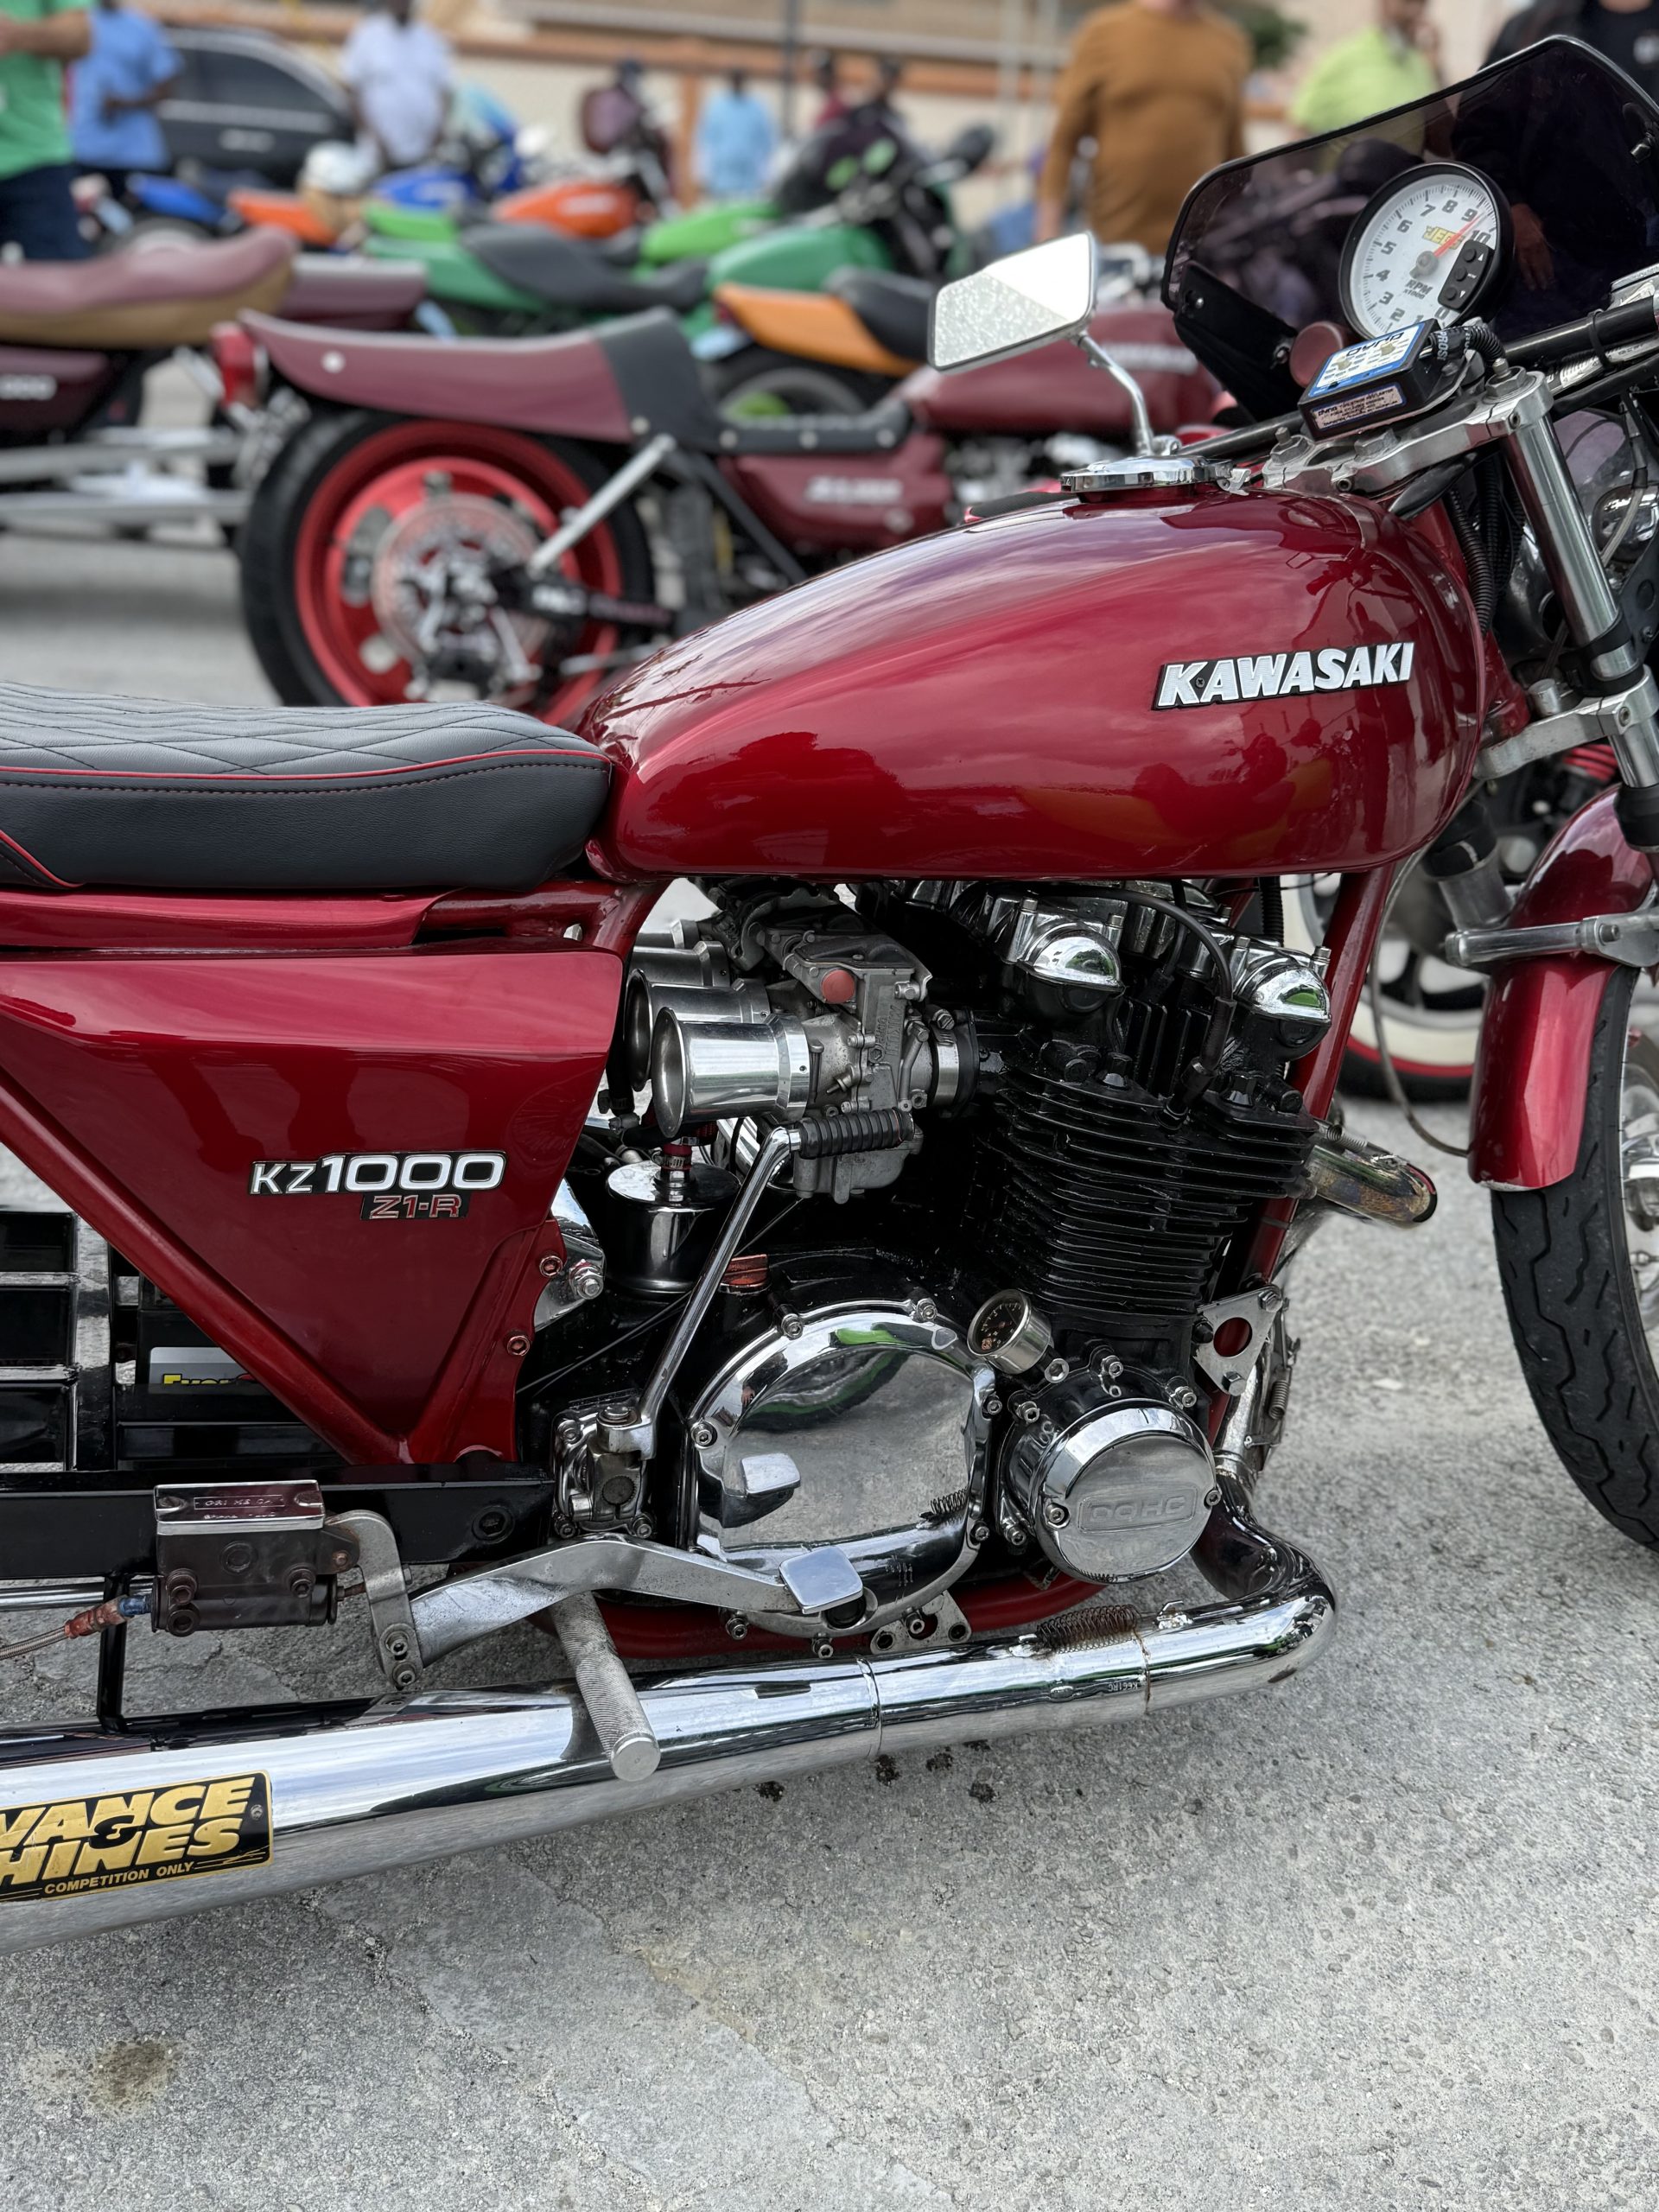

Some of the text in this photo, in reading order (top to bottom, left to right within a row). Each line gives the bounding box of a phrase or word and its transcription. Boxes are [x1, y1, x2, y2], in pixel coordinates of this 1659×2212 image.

[1421, 204, 1435, 216] 7
[1441, 199, 1458, 213] 8
[1461, 207, 1478, 222] 9
[1397, 219, 1413, 233] 6
[1470, 229, 1491, 245] 10
[1381, 240, 1396, 256] 5
[1376, 269, 1390, 282] 4
[1405, 281, 1433, 296] RPM
[1379, 291, 1394, 305] 3
[1390, 308, 1405, 321] 2
[1434, 306, 1450, 320] 0
[1157, 642, 1414, 707] KAWASAKI
[250, 1154, 506, 1194] KZ1000
[369, 1193, 462, 1219] Z1-R
[0, 1777, 255, 1850] VANCE
[0, 1817, 243, 1885] HINES
[44, 1861, 194, 1895] COMPETITION ONLY
